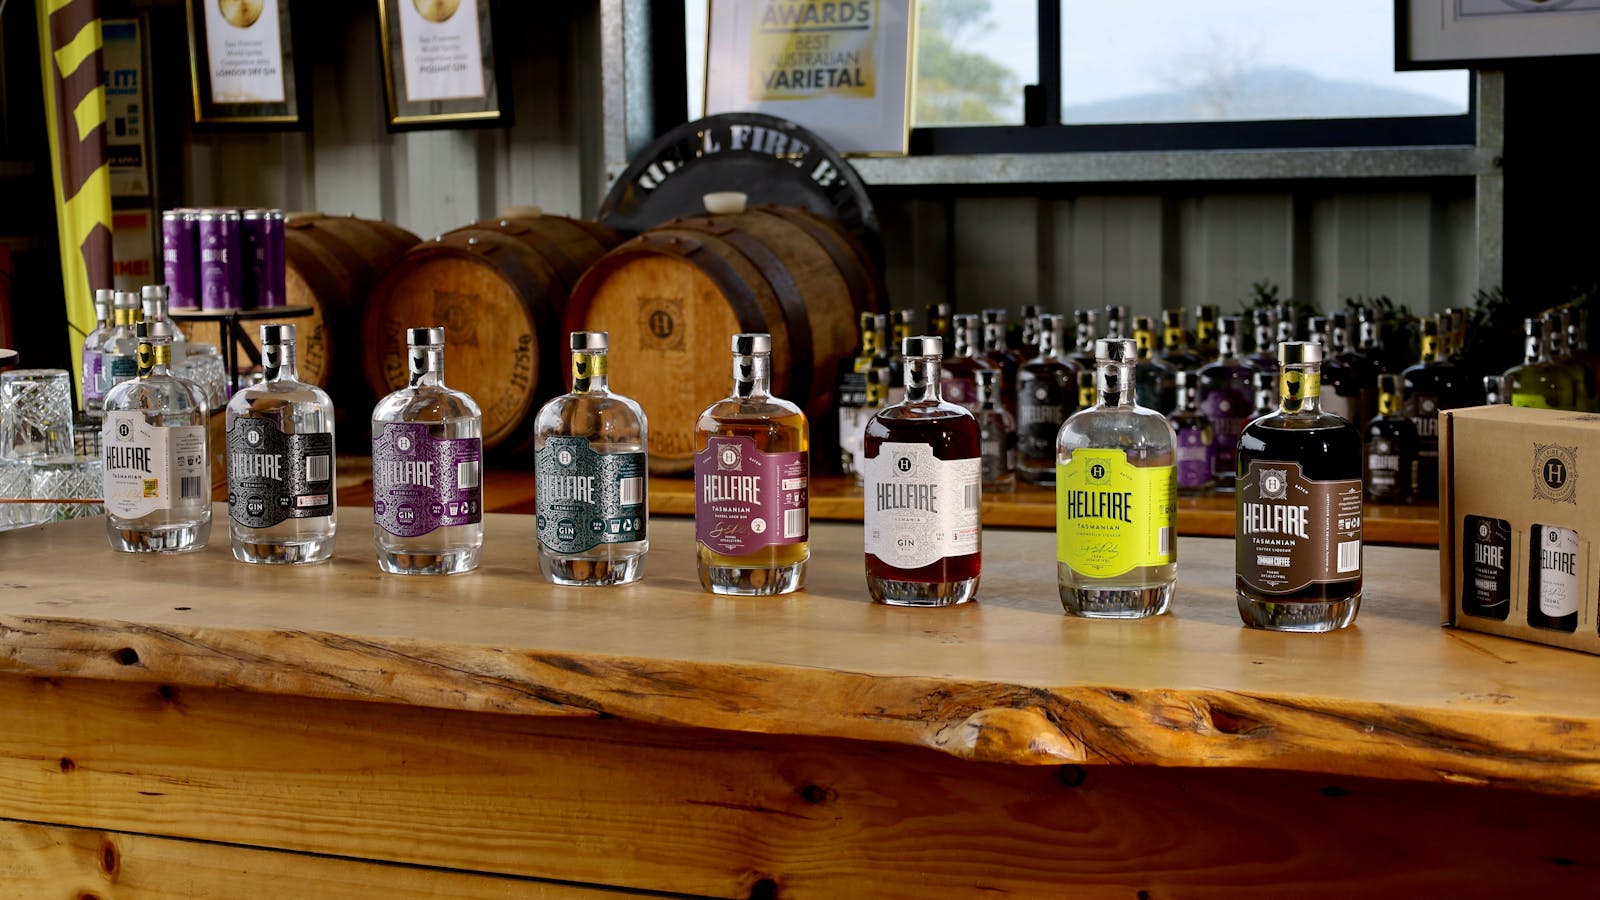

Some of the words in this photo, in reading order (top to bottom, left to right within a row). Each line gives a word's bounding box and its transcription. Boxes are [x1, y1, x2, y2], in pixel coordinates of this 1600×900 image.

[761, 1, 870, 25] AWARDS
[795, 34, 830, 50] BEST
[768, 51, 859, 67] AUSTRALIAN
[761, 68, 866, 89] VARIETAL
[730, 124, 812, 168] FIRE
[106, 446, 152, 473] HELLFIRE
[232, 452, 282, 481] HELLFIRE
[381, 461, 435, 489] HELLFIRE
[1547, 463, 1563, 483] H
[542, 475, 595, 505] HELLFIRE
[703, 474, 761, 506] HELLFIRE
[877, 483, 938, 513] HELLFIRE
[1295, 484, 1309, 494] BATCH
[1068, 490, 1132, 524] HELLFIRE
[559, 527, 574, 535] GIN
[1243, 502, 1309, 540] HELLFIRE
[898, 539, 915, 547] GIN
[1253, 538, 1296, 546] TASMANIAN
[1274, 557, 1290, 567] COFFEE
